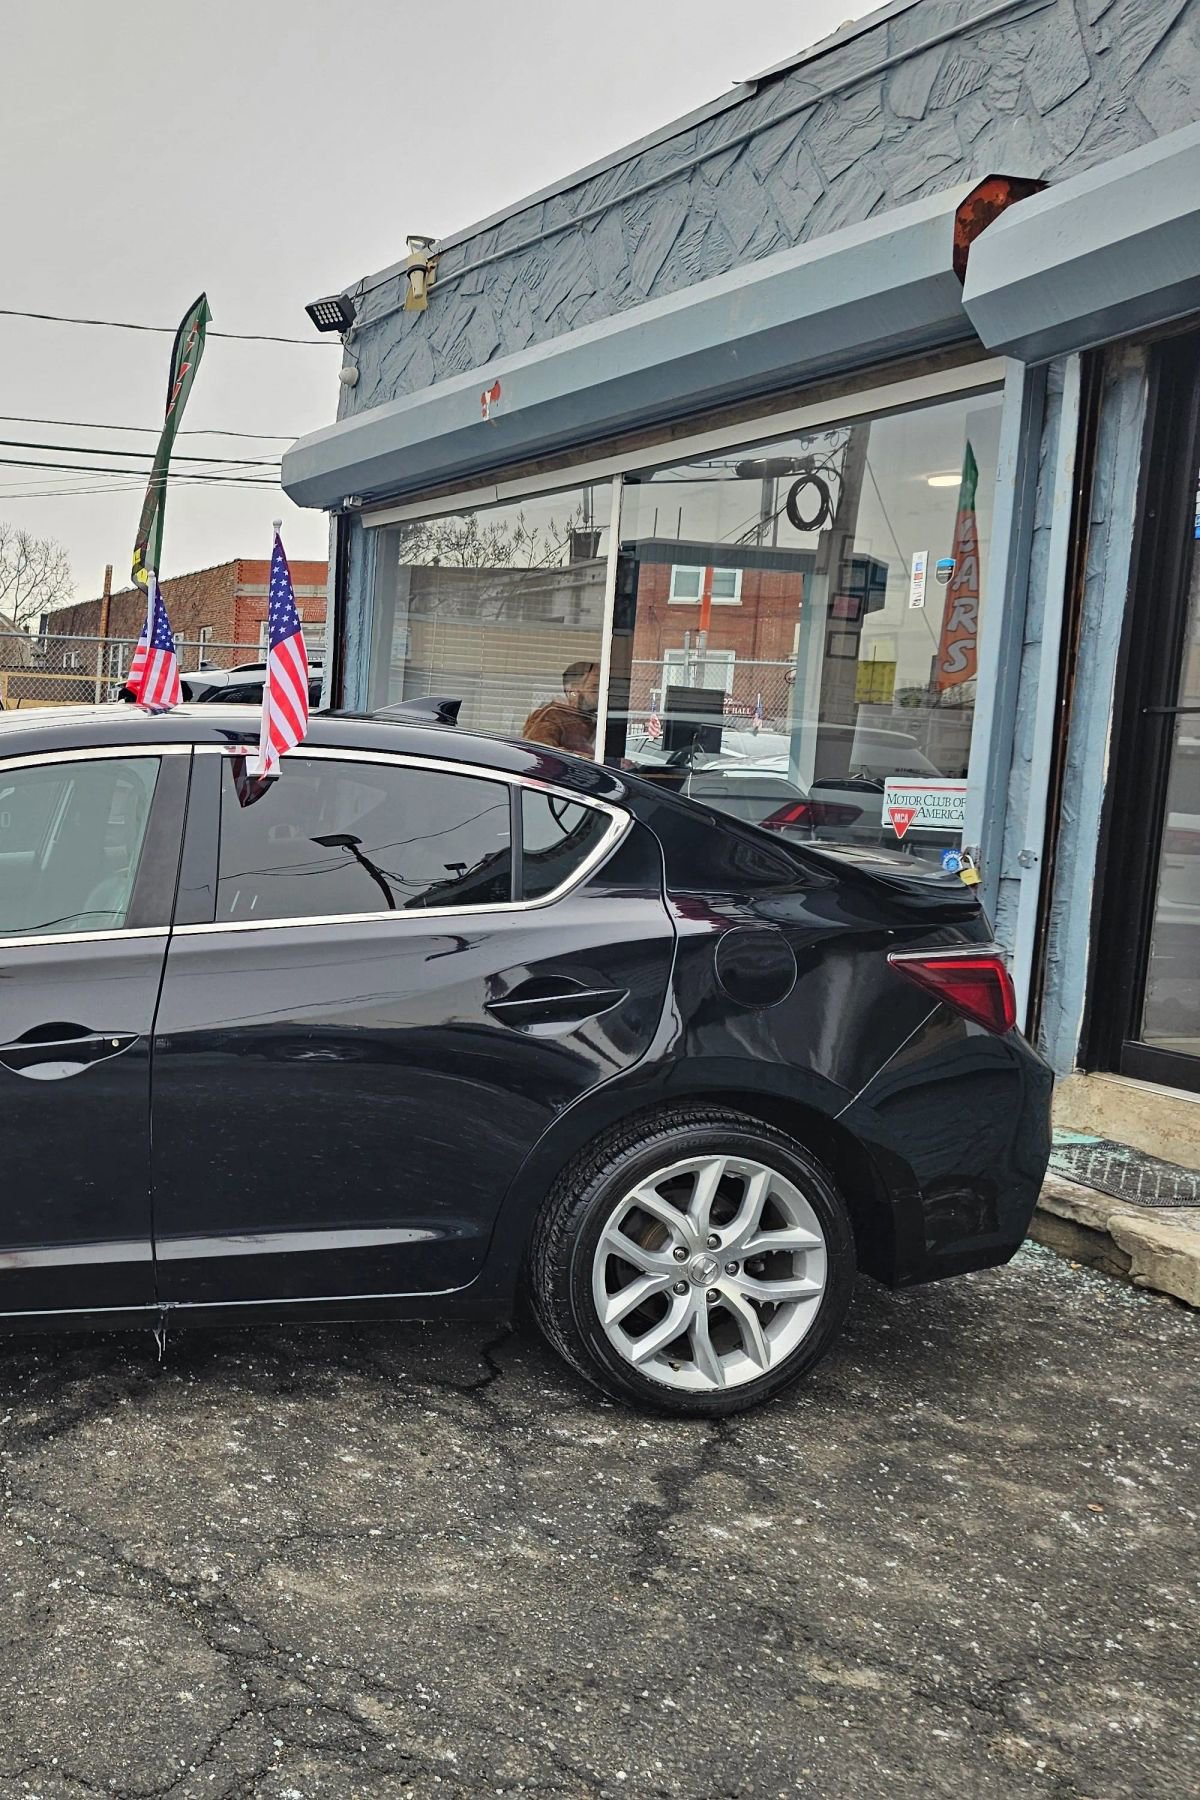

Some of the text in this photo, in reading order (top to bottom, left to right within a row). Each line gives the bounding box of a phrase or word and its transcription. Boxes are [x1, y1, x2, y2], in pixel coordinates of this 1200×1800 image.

[886, 793, 967, 808] MOTOR CLUB OF
[894, 813, 909, 823] MCA
[916, 807, 965, 820] AMERICA
